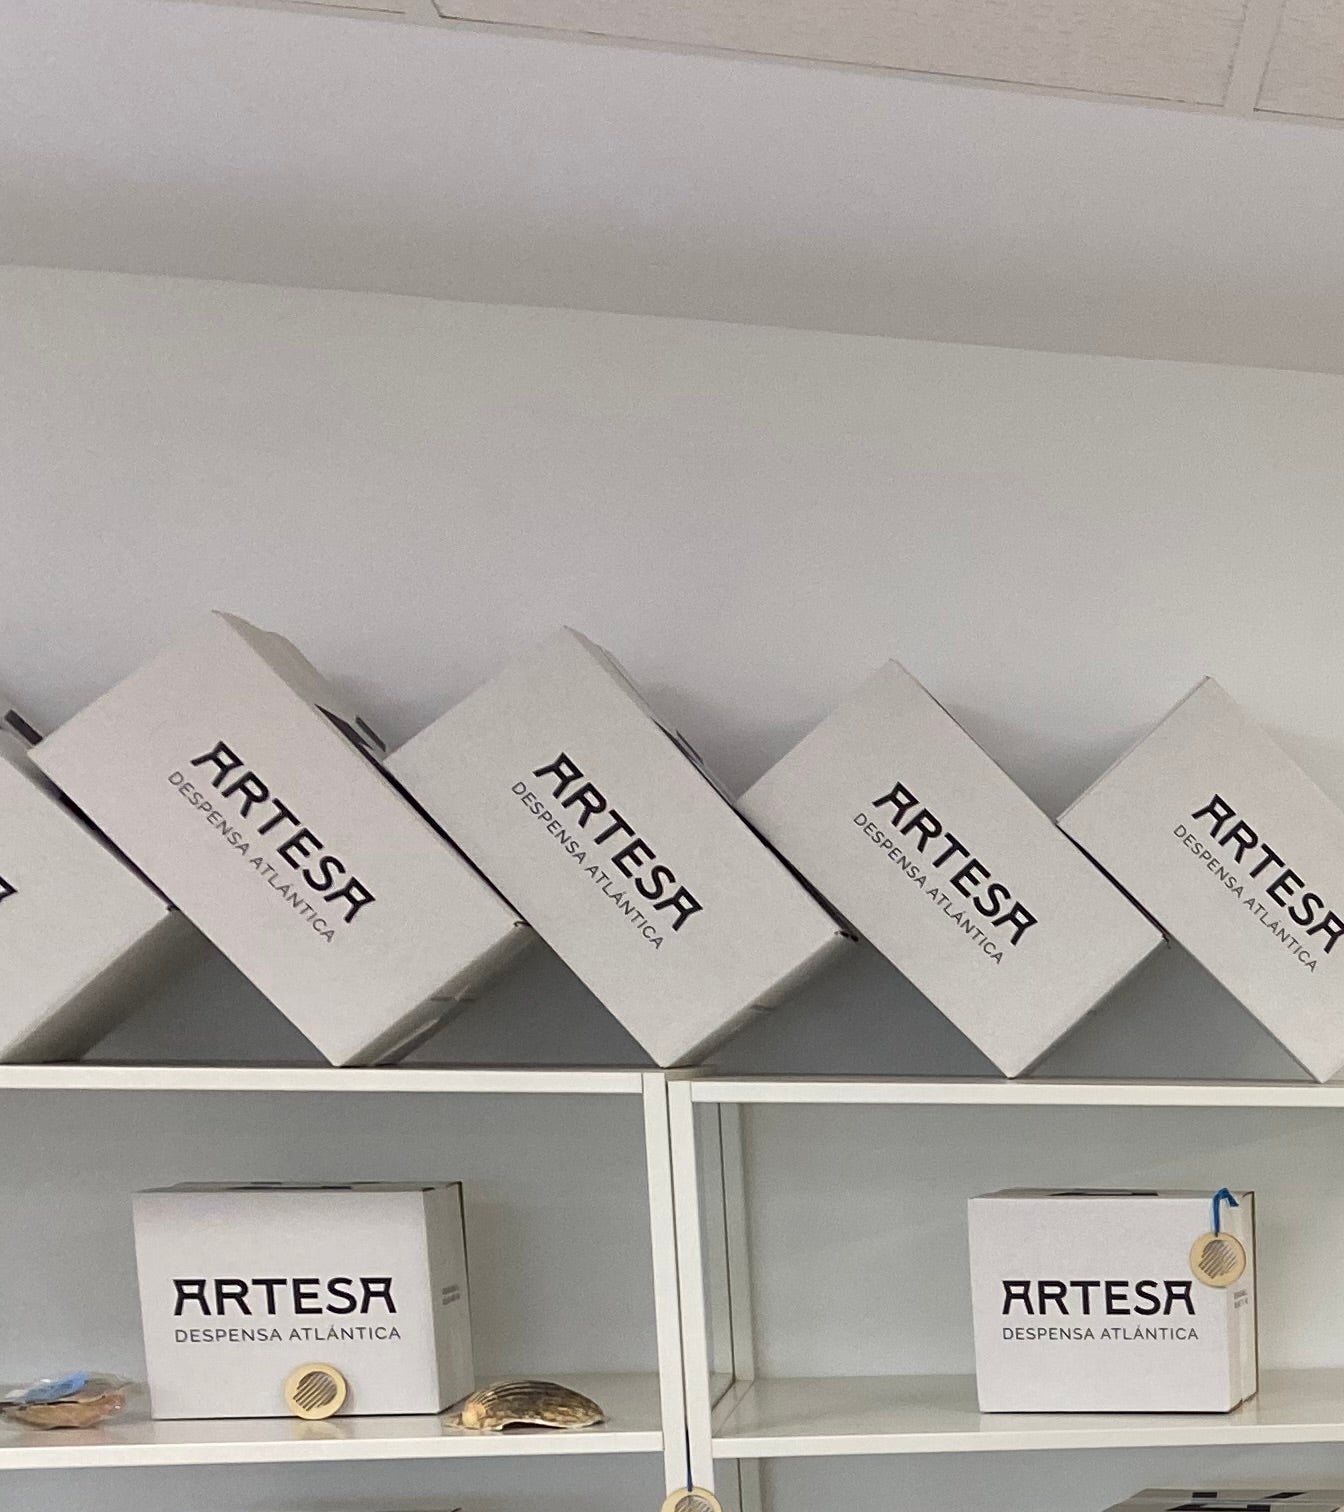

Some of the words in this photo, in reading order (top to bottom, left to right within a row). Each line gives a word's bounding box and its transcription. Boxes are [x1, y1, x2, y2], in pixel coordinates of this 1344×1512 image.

[168, 772, 250, 856] DESPENSA
[250, 856, 337, 943] ATLÁNTICA
[190, 740, 376, 924] ARTESA
[511, 781, 587, 868] DESPENSA
[583, 865, 663, 950] ATLÁNTICA
[533, 751, 703, 932] ARTESA
[853, 812, 927, 889] DESPENSA
[925, 887, 1003, 965] ATLÁNTICA
[872, 780, 1038, 947] ARTESA
[1173, 824, 1244, 899] DESPENSA
[1242, 897, 1317, 972] ATLÁNTICA
[172, 1276, 398, 1317] ARTESA
[174, 1328, 283, 1343] DESPENSA
[288, 1323, 401, 1341] ATLÁNTICA
[1001, 1279, 1196, 1316] ARTESA
[1002, 1327, 1096, 1341] DESPENSA
[1099, 1323, 1199, 1341] ATLÁNTICA
